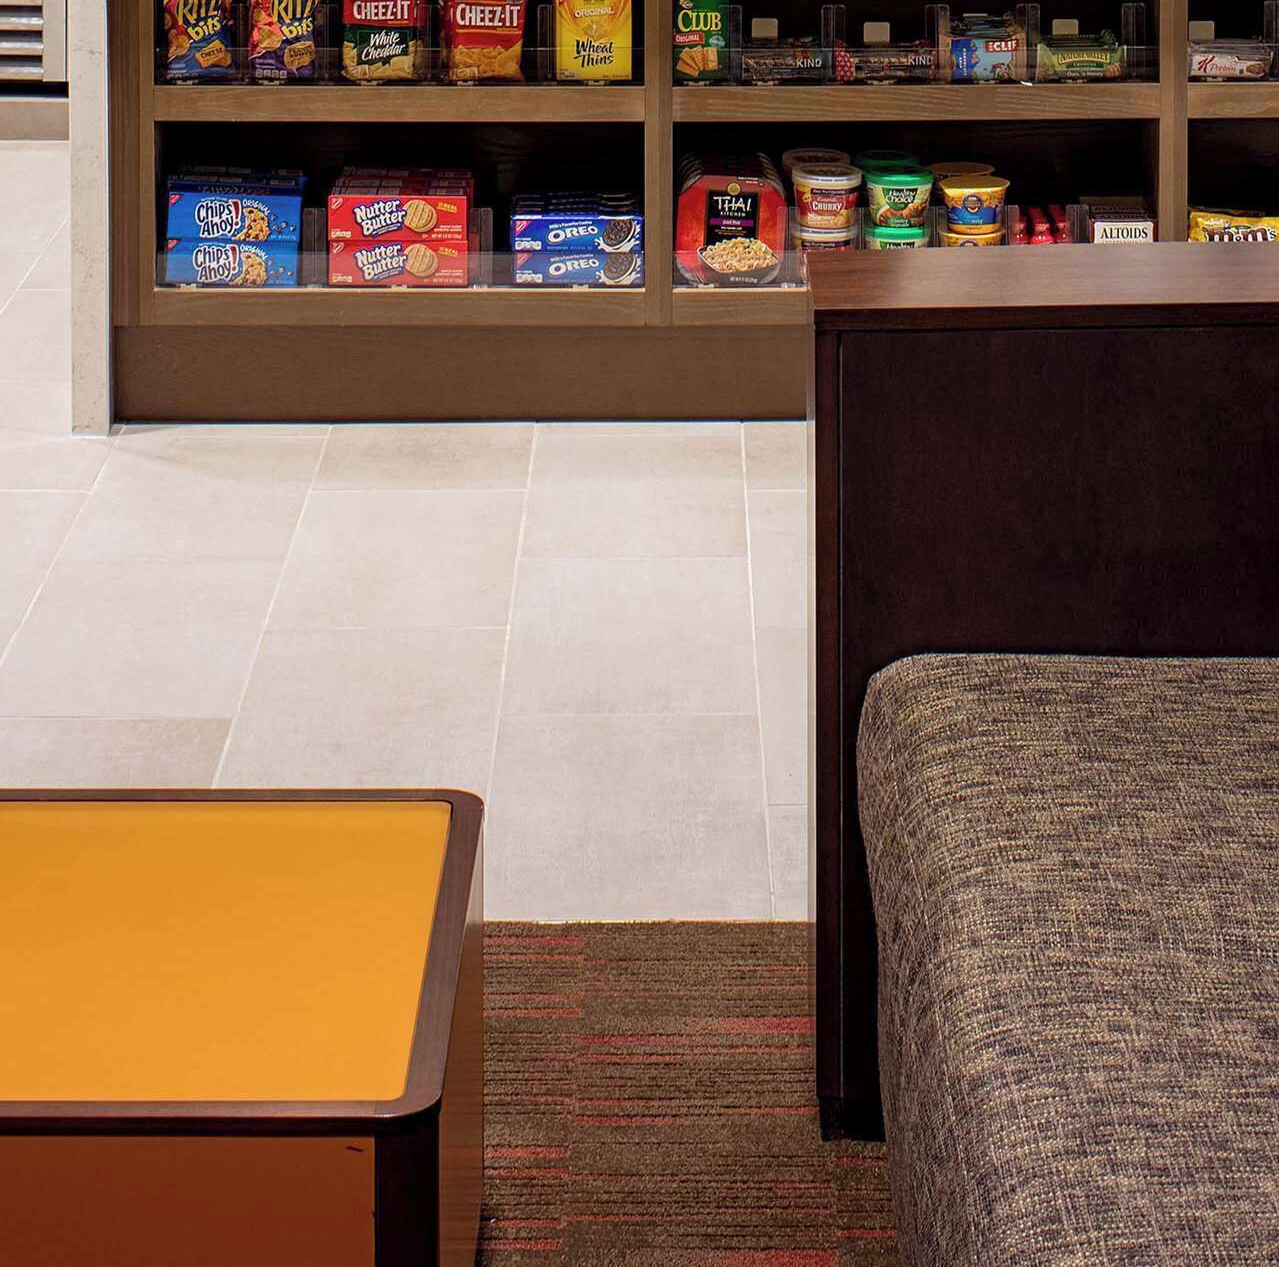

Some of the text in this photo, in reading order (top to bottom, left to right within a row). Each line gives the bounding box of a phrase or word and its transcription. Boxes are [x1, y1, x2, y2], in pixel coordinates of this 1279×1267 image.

[574, 6, 614, 18] ORIGINAL
[677, 10, 721, 32] CLUB
[187, 16, 223, 41] bits
[281, 17, 313, 39] bits
[369, 29, 400, 48] White
[575, 38, 614, 55] Wheat
[361, 42, 406, 62] Cheddar
[574, 53, 614, 68] Thins
[908, 55, 933, 66] KIND
[796, 57, 822, 68] KIND
[243, 199, 270, 215] ORIGINAL
[713, 196, 752, 212] THAI
[812, 201, 842, 212] CHUNKY
[885, 194, 914, 204] Choice
[196, 200, 233, 223] Chips
[354, 200, 401, 223] Nutter
[361, 210, 406, 235] Butter
[547, 226, 598, 244] OREO
[1100, 227, 1148, 239] ALTOIDS
[193, 245, 230, 268] Chips
[356, 244, 401, 268] Nutter
[362, 254, 407, 280] Butter
[548, 258, 599, 277] OREO
